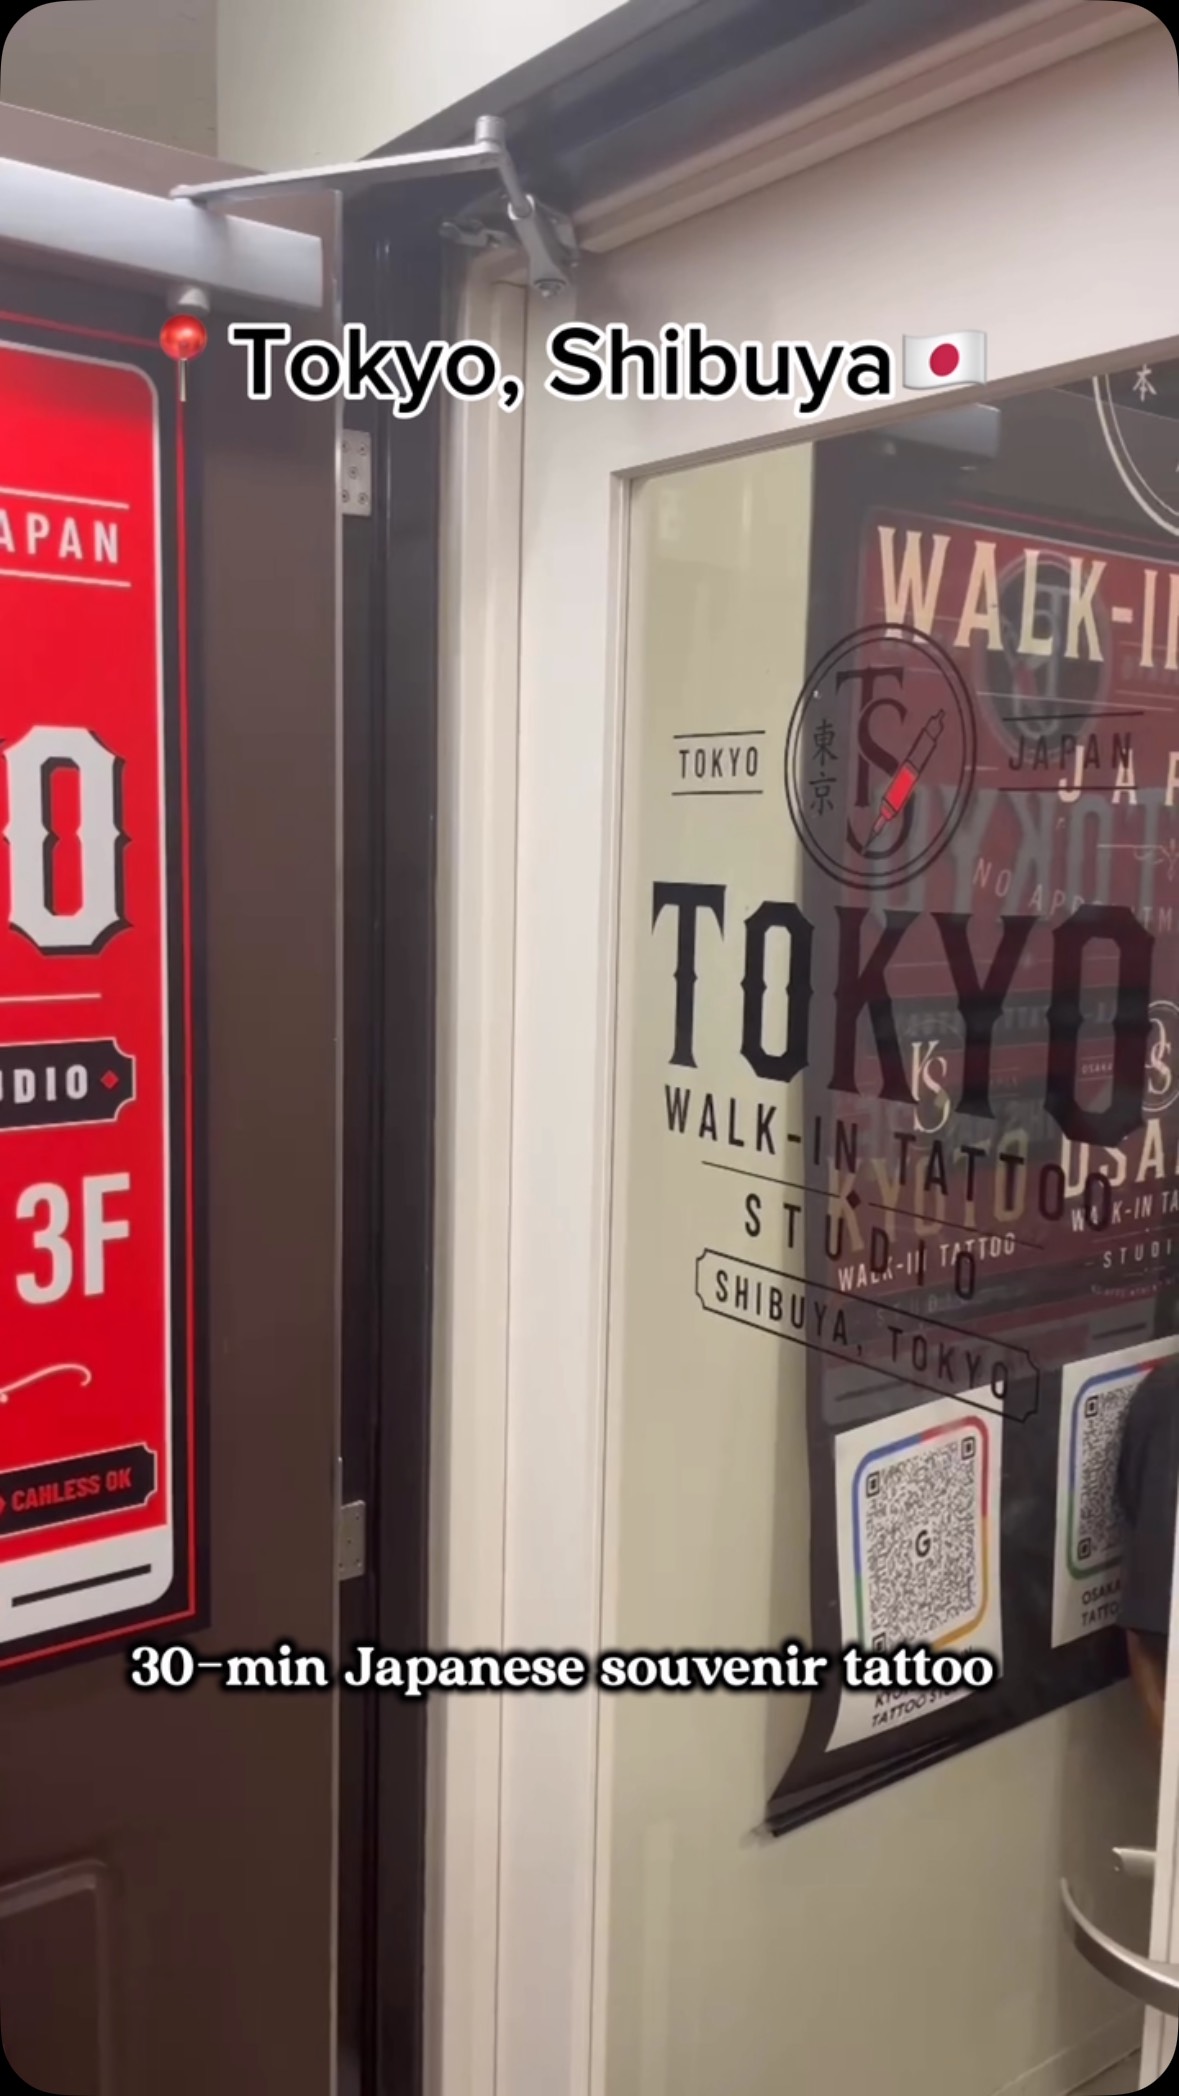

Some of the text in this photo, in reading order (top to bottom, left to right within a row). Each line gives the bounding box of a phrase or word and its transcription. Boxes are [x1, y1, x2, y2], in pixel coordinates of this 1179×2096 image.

[678, 745, 760, 779] TOKYO
[808, 717, 839, 818] 東京
[1007, 732, 1132, 771] JAPAN
[972, 857, 1012, 898] NO
[651, 880, 1156, 1148] TOKYO
[664, 1083, 1114, 1233] WALK-IN TATTOO
[826, 1127, 1030, 1253] KYOTO
[16, 1171, 131, 1306] 3F
[744, 1192, 977, 1301] STUDIO
[1071, 1194, 1153, 1232] WAK-IN
[715, 1267, 1011, 1400] SHIBUYA, TOKYO
[105, 1467, 133, 1492] OK
[915, 1529, 932, 1558] G
